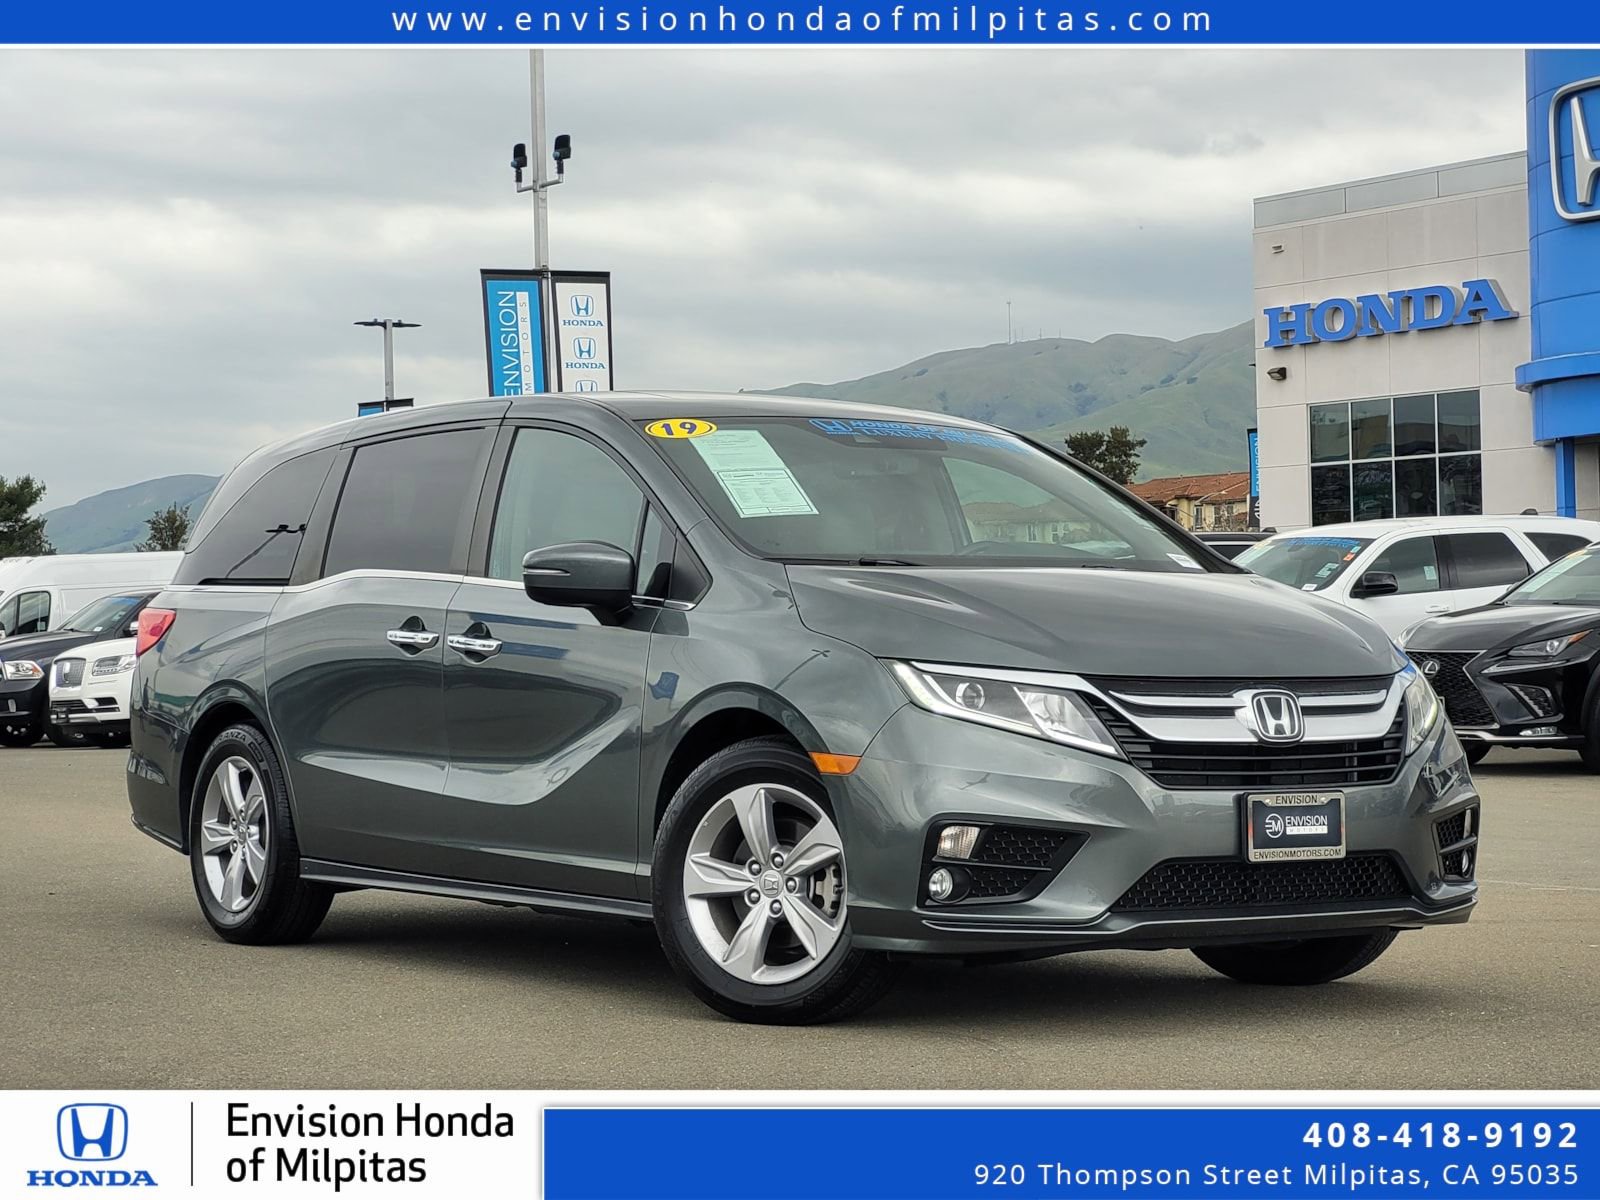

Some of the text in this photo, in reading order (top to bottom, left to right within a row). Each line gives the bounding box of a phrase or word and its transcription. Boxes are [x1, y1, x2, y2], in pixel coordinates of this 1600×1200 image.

[1264, 279, 1519, 348] HONDA
[562, 319, 604, 327] HONDA
[498, 291, 521, 396] ENVISION
[519, 301, 532, 392] MOTORS
[661, 421, 698, 436] 19
[1275, 794, 1318, 805] ENVISION
[1285, 815, 1328, 826] ENVISION
[1253, 849, 1342, 860] ENVISIONMOTORS.COM
